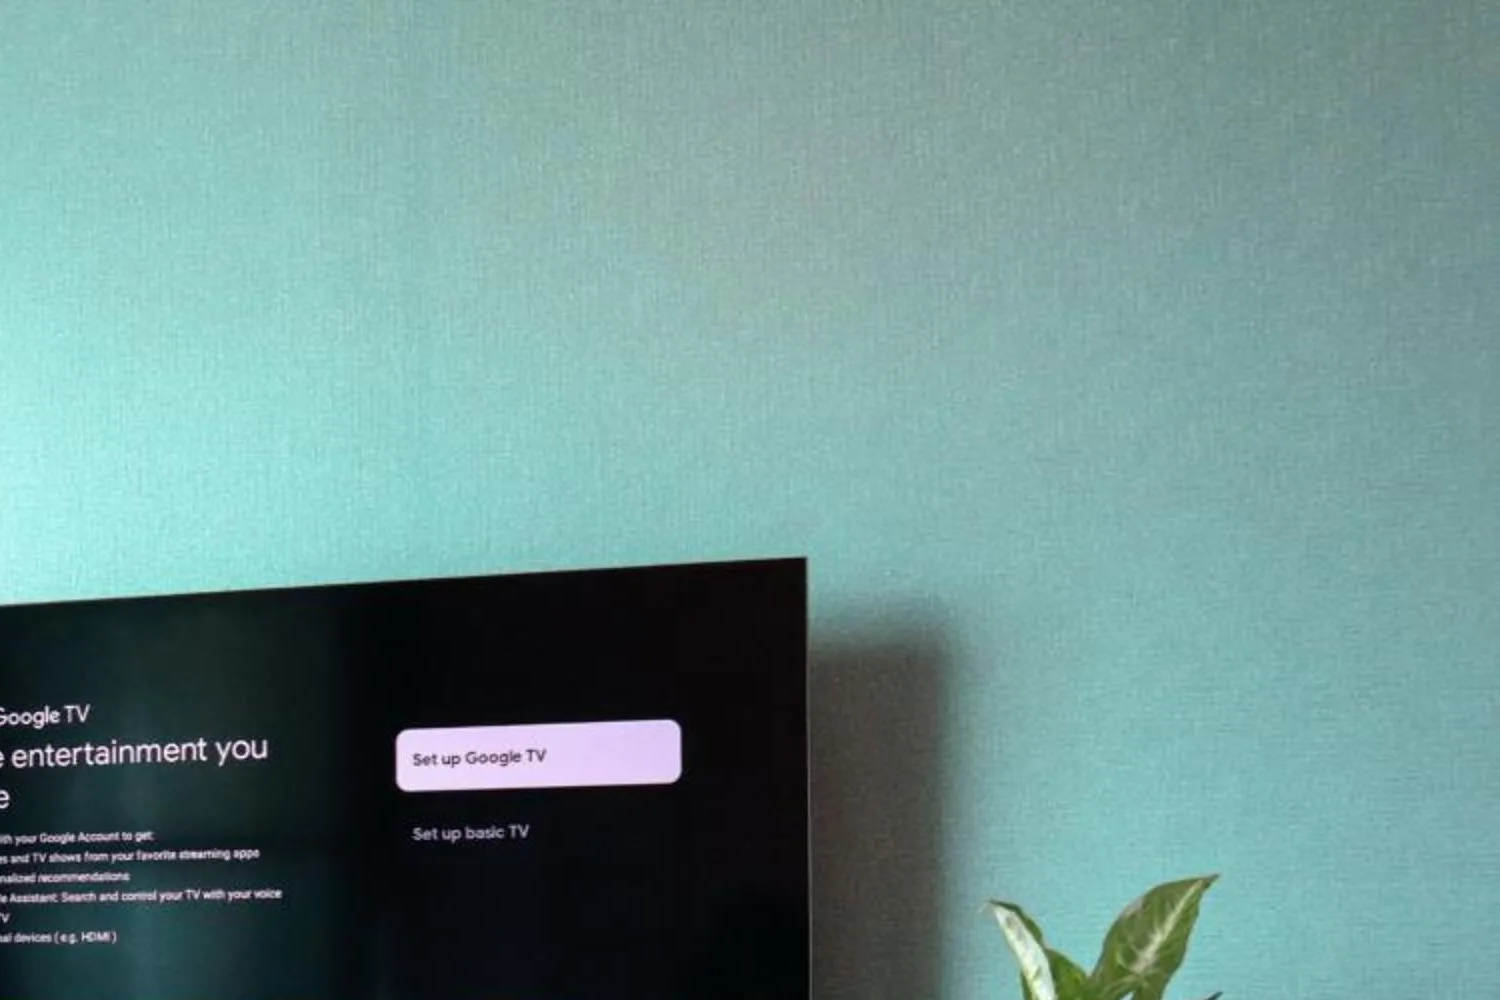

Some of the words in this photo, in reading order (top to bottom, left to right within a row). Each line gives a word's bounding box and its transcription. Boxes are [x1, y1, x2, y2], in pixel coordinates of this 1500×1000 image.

[64, 705, 91, 724] TV
[11, 737, 208, 767] entertainment
[215, 739, 268, 766] you
[412, 753, 438, 767] Set
[441, 755, 461, 768] up
[465, 750, 522, 767] Google
[525, 748, 547, 762] TV
[15, 835, 37, 847] your
[39, 832, 76, 845] Google
[78, 831, 120, 842] Account
[121, 831, 132, 841] to
[412, 827, 438, 841] Set
[441, 829, 462, 844] up
[465, 826, 505, 839] basic
[508, 824, 530, 838] TV
[10, 853, 30, 863] and
[32, 852, 47, 862] TV
[49, 852, 81, 863] shows
[83, 851, 109, 862] from
[111, 851, 134, 864] your
[136, 850, 176, 861] favorite
[178, 849, 231, 861] streaming
[233, 849, 261, 861] apps
[38, 872, 131, 883] recommendations
[60, 891, 97, 902] Search
[98, 890, 119, 901] and
[121, 889, 157, 901] control
[159, 891, 183, 903] your
[184, 889, 200, 900] TV
[202, 888, 226, 900] with
[227, 890, 253, 903] your
[254, 888, 283, 899] voice
[13, 931, 52, 943] devices
